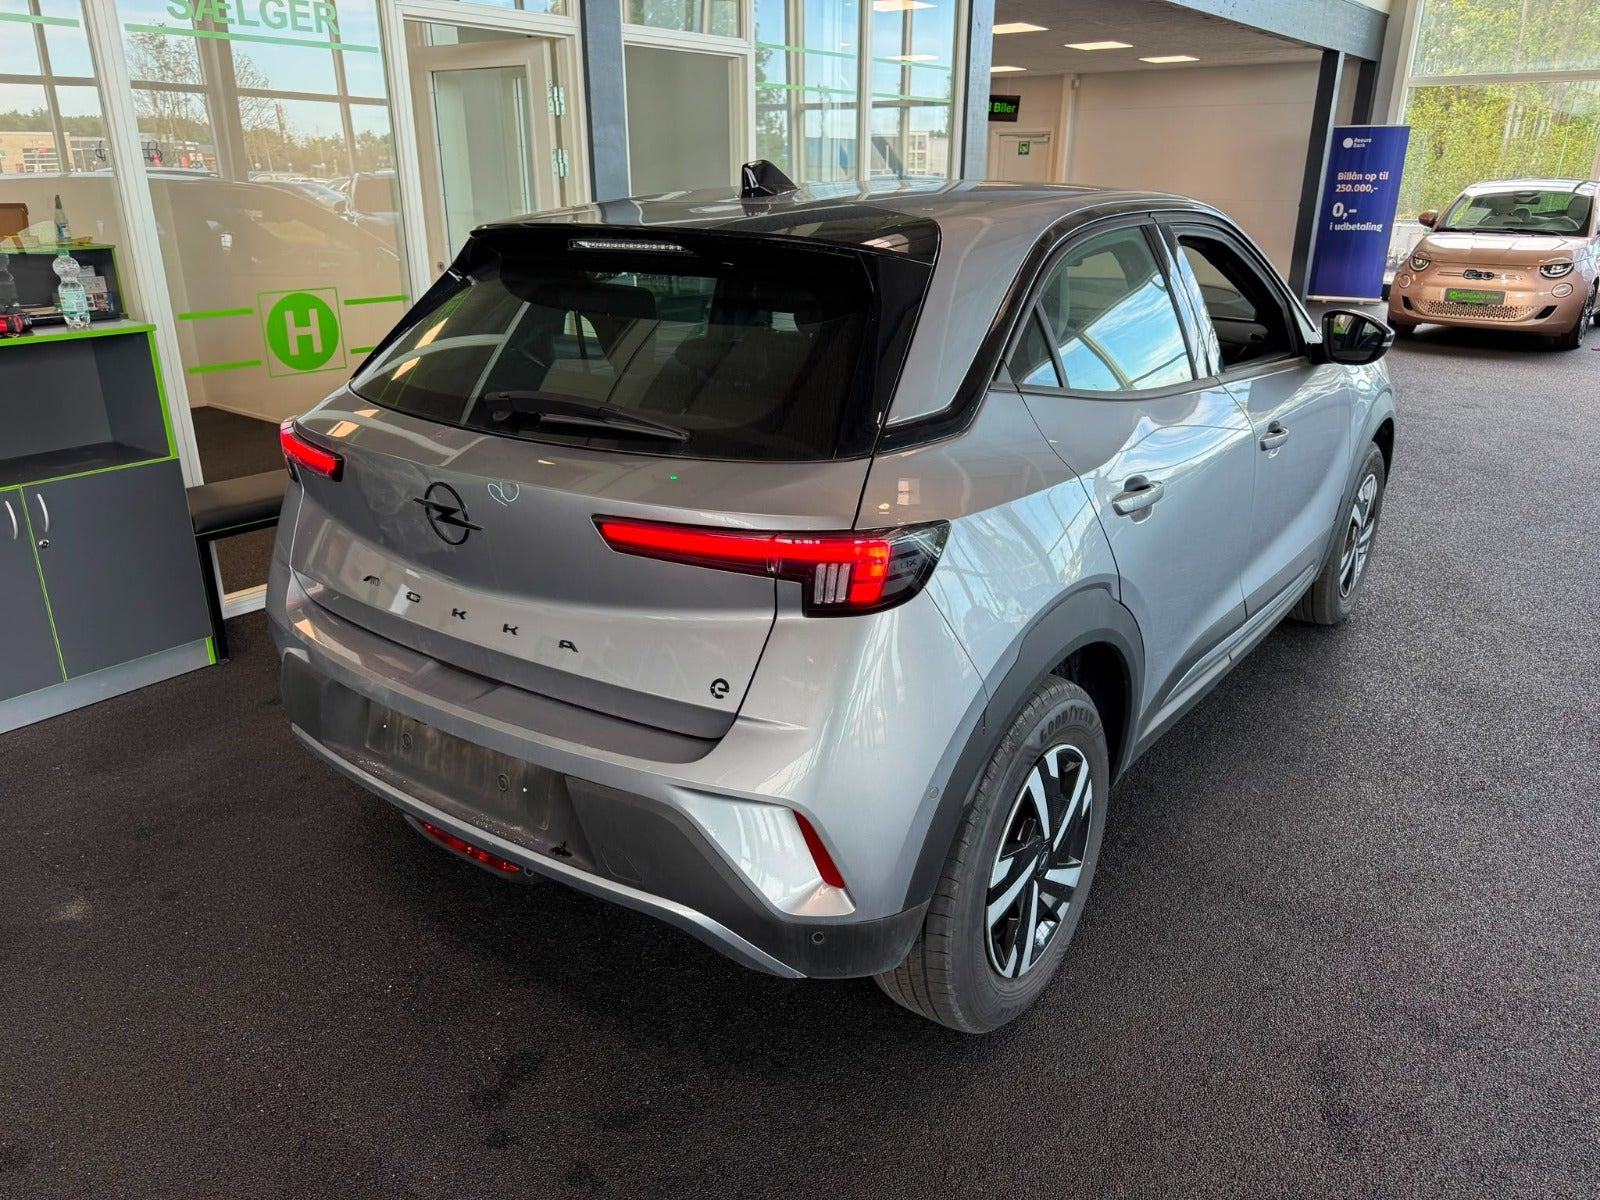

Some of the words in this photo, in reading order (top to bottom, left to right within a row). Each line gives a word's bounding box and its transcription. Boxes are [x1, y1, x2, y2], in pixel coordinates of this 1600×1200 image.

[166, 0, 340, 36] SÆLGER
[993, 102, 1017, 113] Biler
[1337, 172, 1363, 181] Billån
[1364, 174, 1377, 182] op
[1378, 171, 1389, 180] til
[1335, 184, 1379, 193] 250.000,-
[1334, 222, 1383, 232] udbetaling
[284, 308, 323, 356] H
[362, 575, 579, 653] MOKKA
